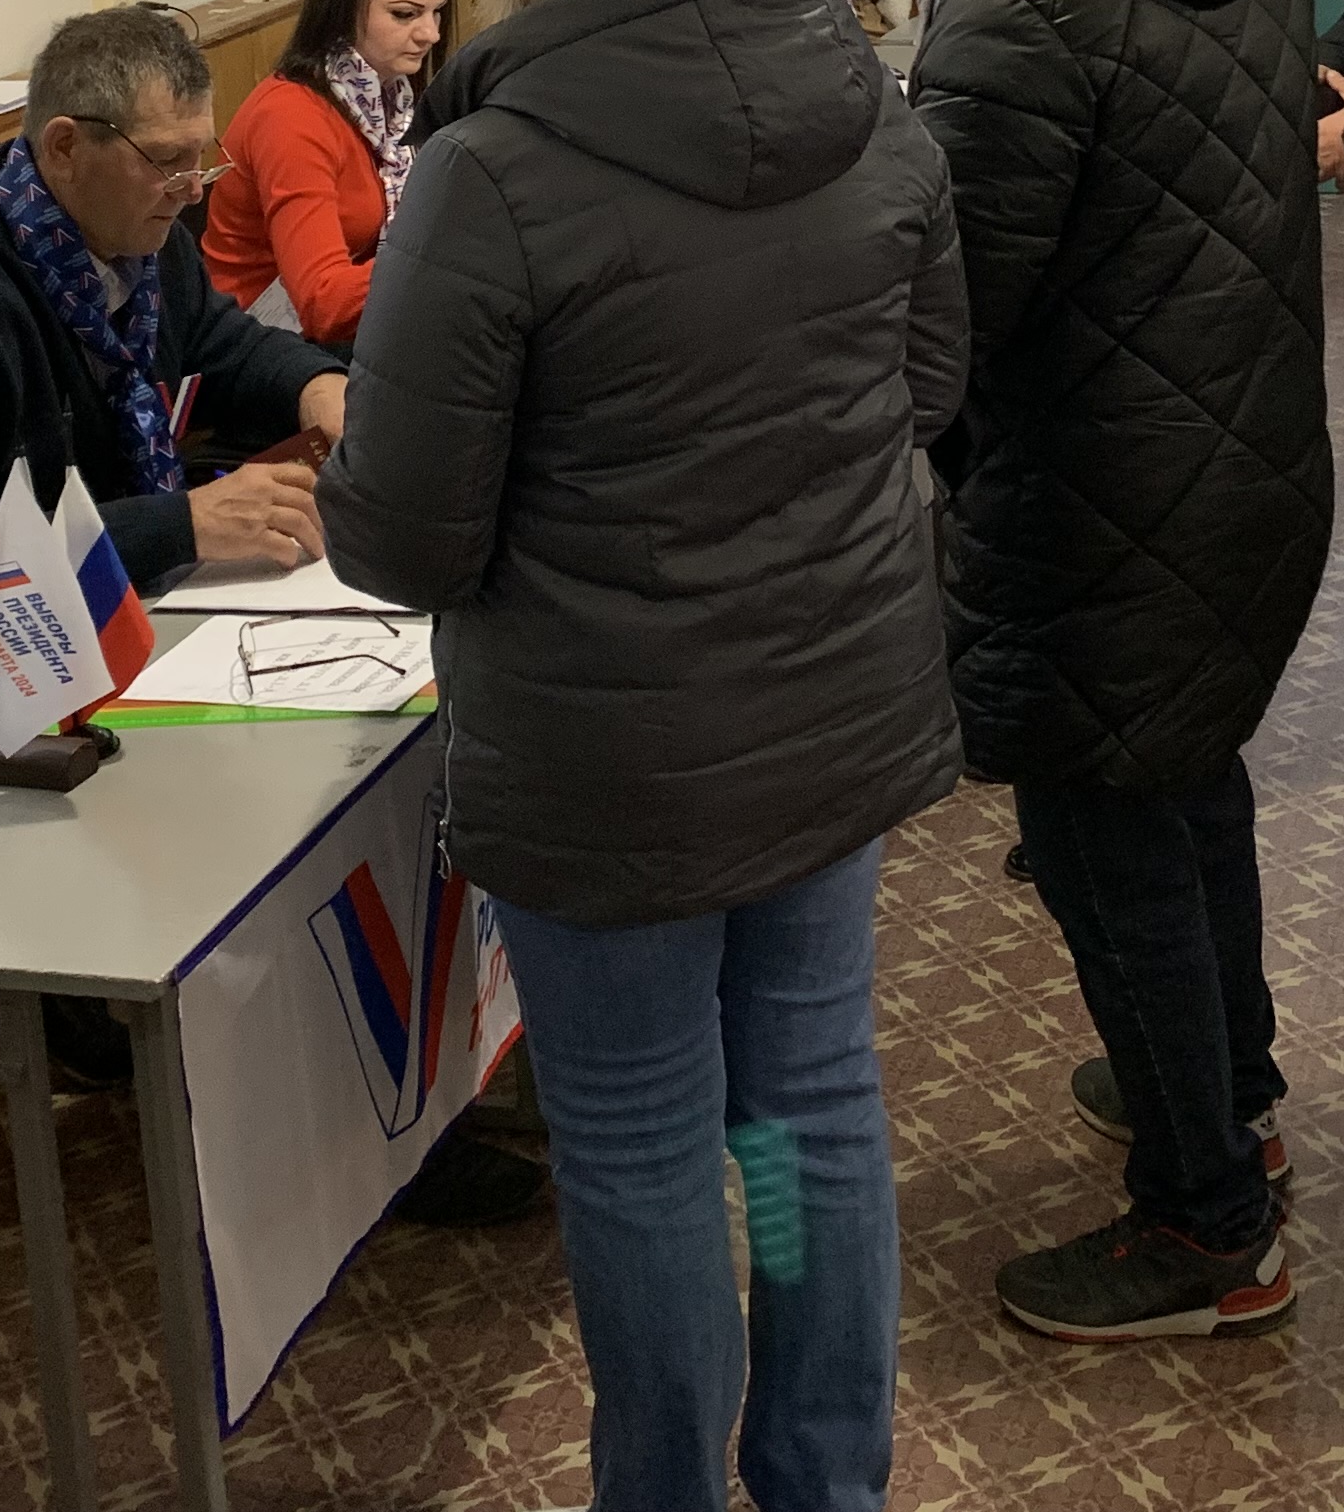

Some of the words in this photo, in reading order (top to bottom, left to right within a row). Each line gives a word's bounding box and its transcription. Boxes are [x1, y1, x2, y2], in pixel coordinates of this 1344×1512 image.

[3, 597, 73, 684] ПРЕЗИДЕНТА
[25, 592, 77, 655] ВЫБОРЫ
[11, 674, 38, 697] 2024
